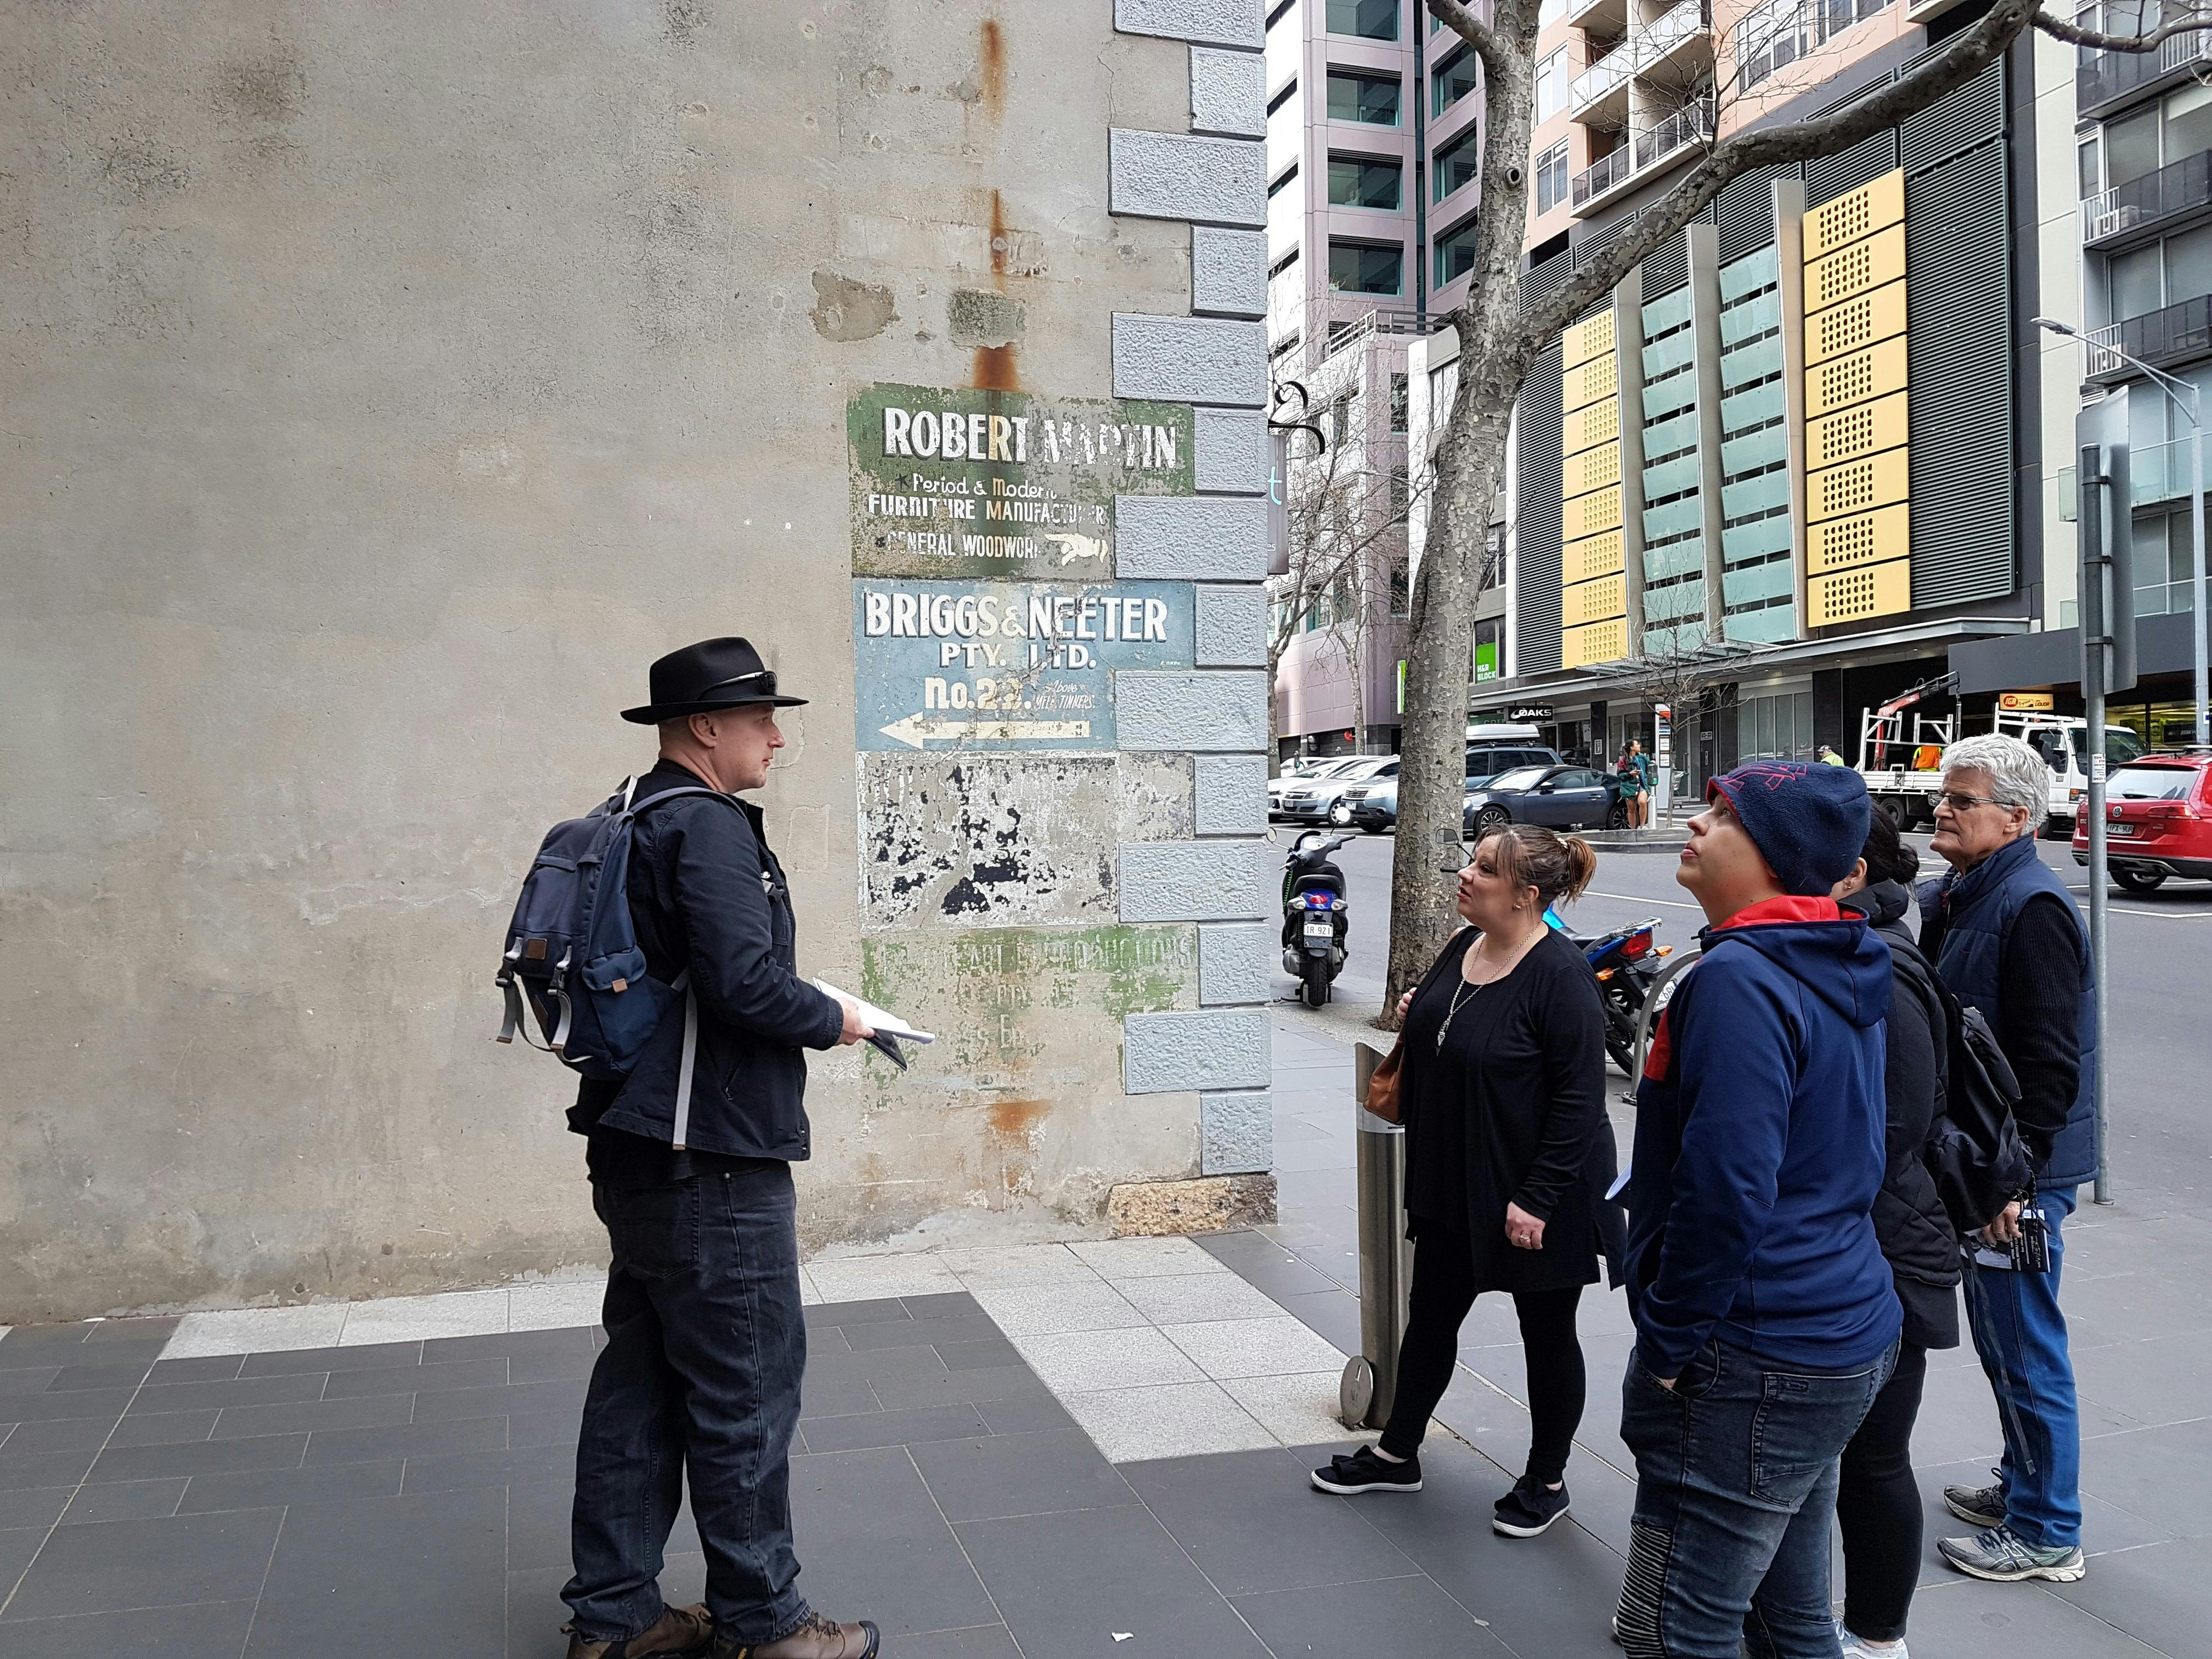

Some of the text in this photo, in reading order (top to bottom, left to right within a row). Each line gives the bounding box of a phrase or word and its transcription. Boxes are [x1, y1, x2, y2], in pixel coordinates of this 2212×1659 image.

[883, 407, 1029, 462] ROBERT
[913, 473, 969, 495] Period
[973, 480, 988, 495] &
[986, 500, 1107, 525] MANUFACTUR
[865, 592, 1168, 643] BRIGGS & NEETER
[940, 642, 1007, 668] PTY.
[1477, 671, 1497, 681] BLOCK
